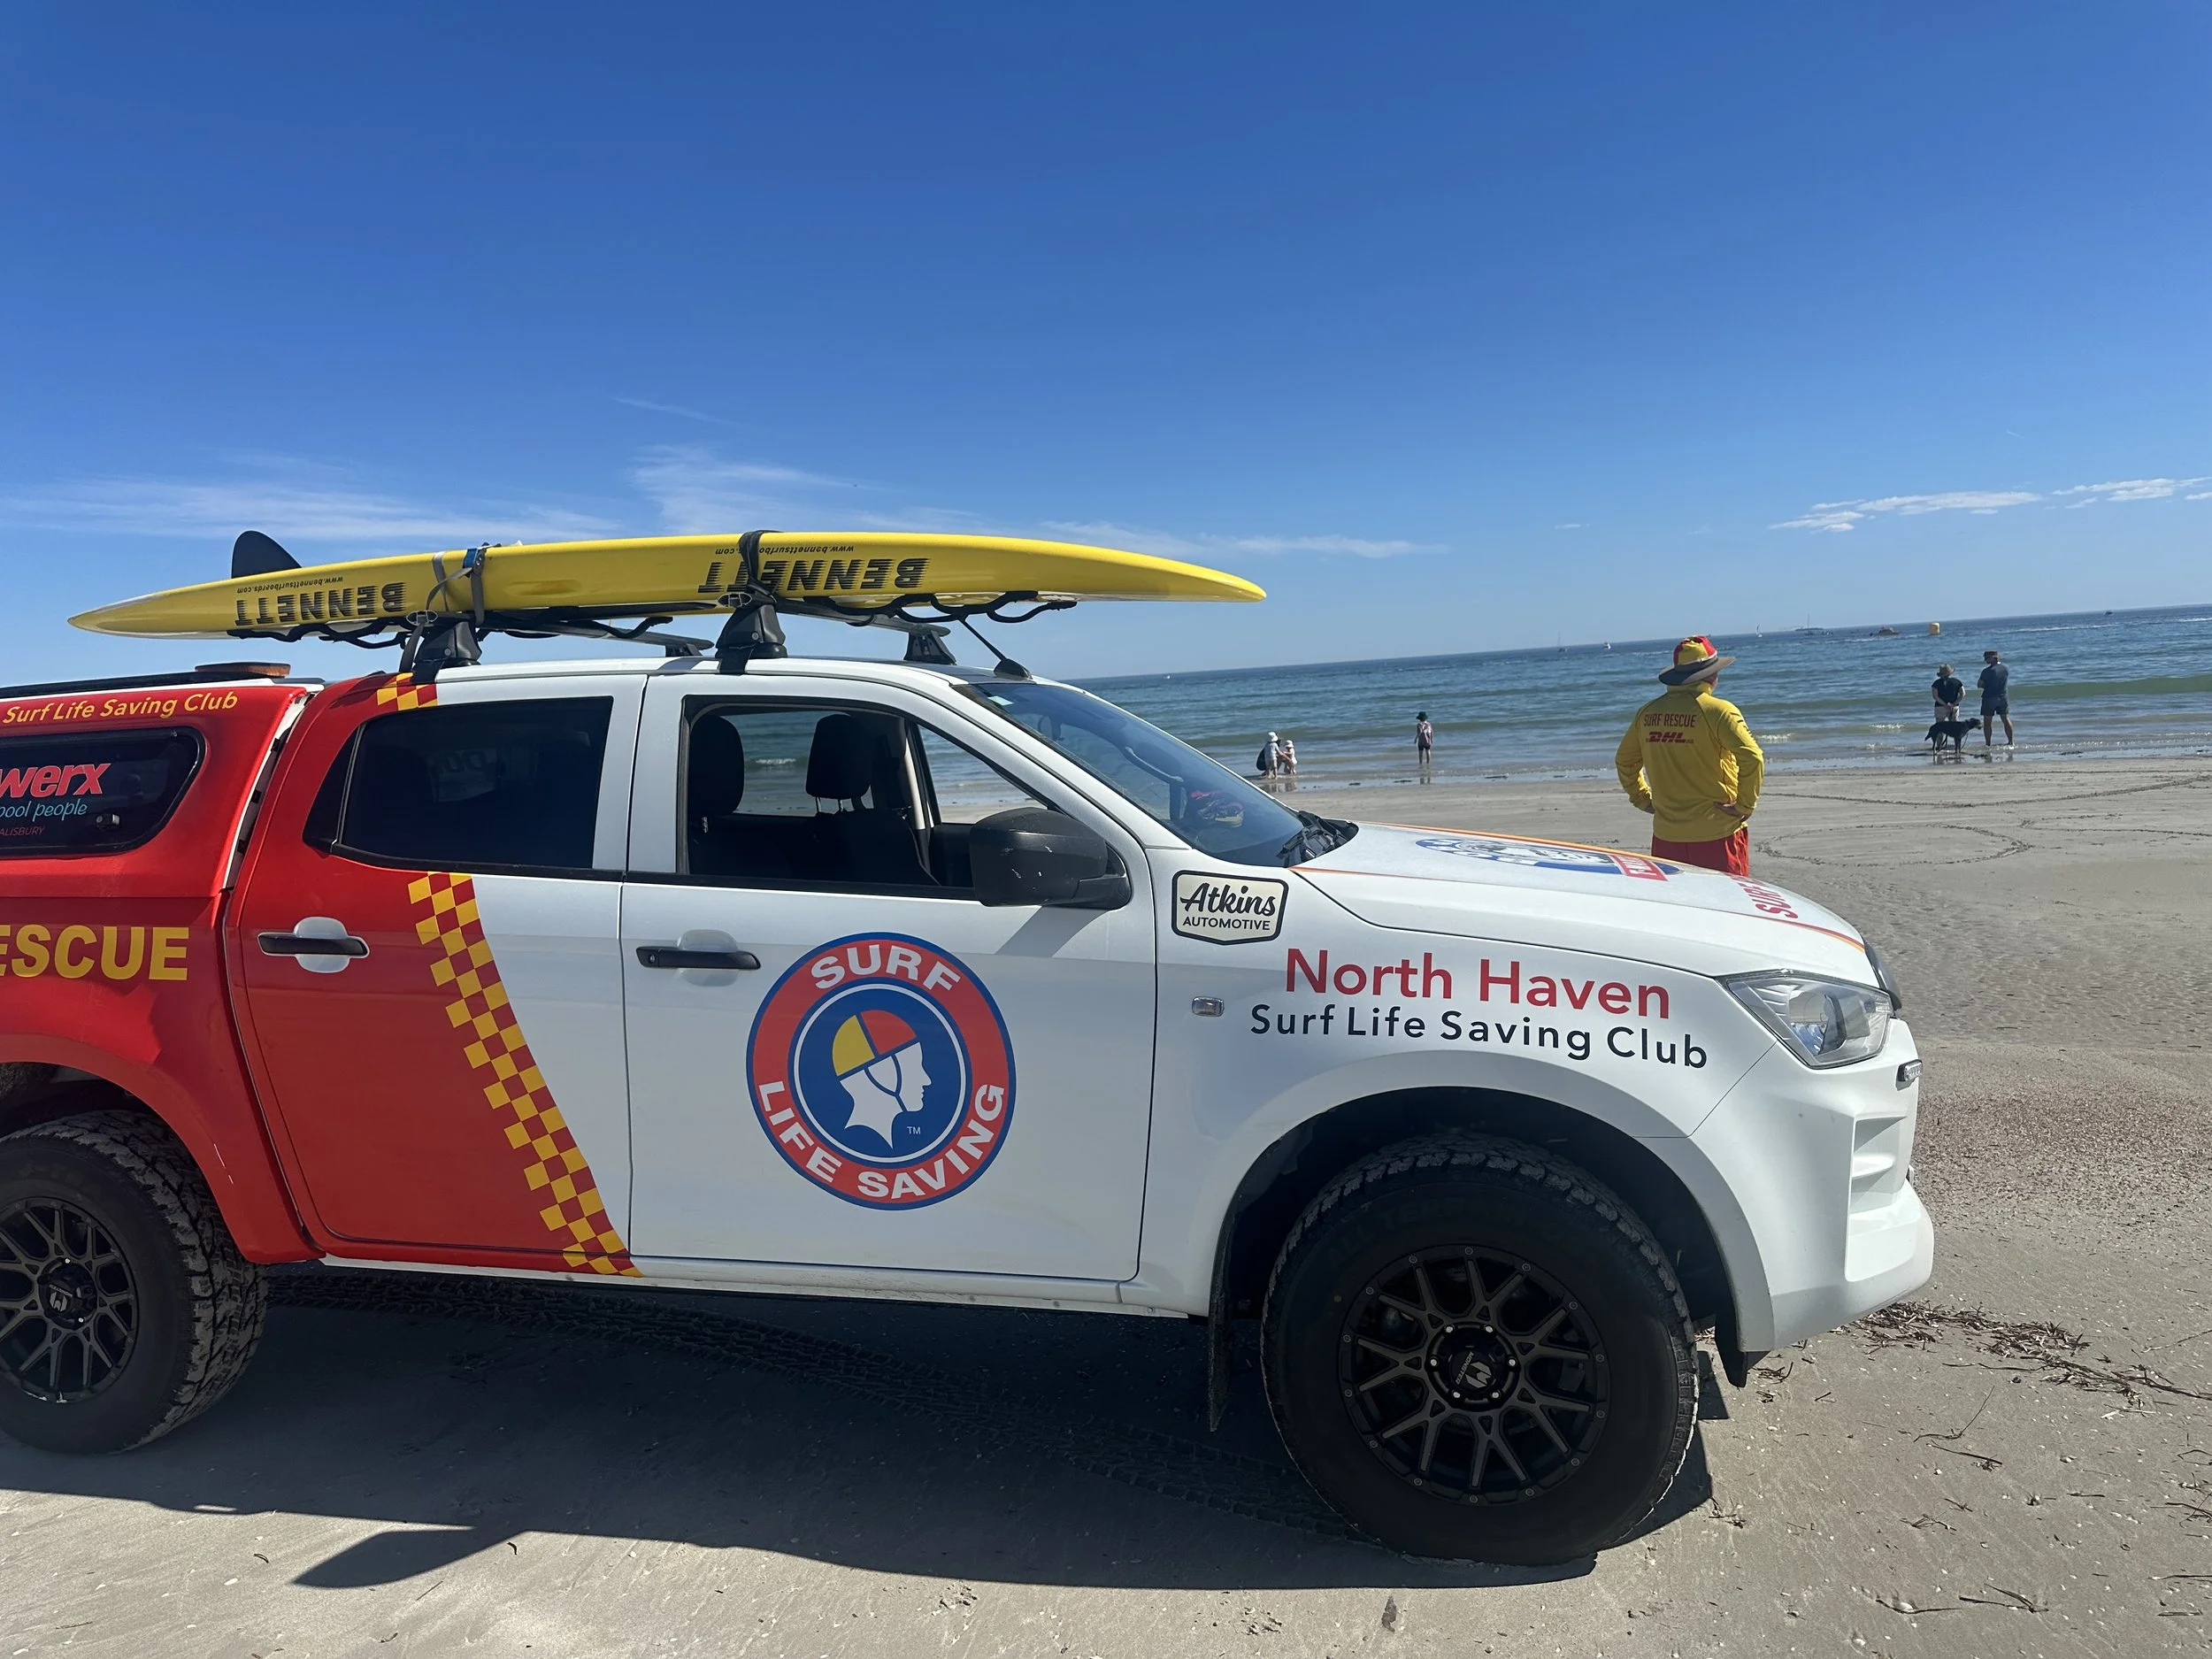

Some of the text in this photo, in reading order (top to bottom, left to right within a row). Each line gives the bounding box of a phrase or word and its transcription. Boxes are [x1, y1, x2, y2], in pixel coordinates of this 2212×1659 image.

[697, 558, 932, 593] BENNETT
[234, 581, 408, 626] BENNETT
[3, 691, 238, 724] Surf Life Saving Club
[1644, 713, 1697, 727] SURF RESCUE
[1648, 732, 1686, 743] DHL
[32, 798, 88, 822] people
[1179, 882, 1276, 917] Atkins
[1183, 916, 1271, 930] AUTOMOTIVE
[0, 924, 189, 980] SCUE
[810, 944, 961, 991] SURF
[1286, 948, 1671, 1019] North Haven
[1250, 1003, 1708, 1069] Surf Life Saving Club
[758, 1080, 1005, 1200] LIFE SAVING
[907, 1126, 922, 1135] TM
